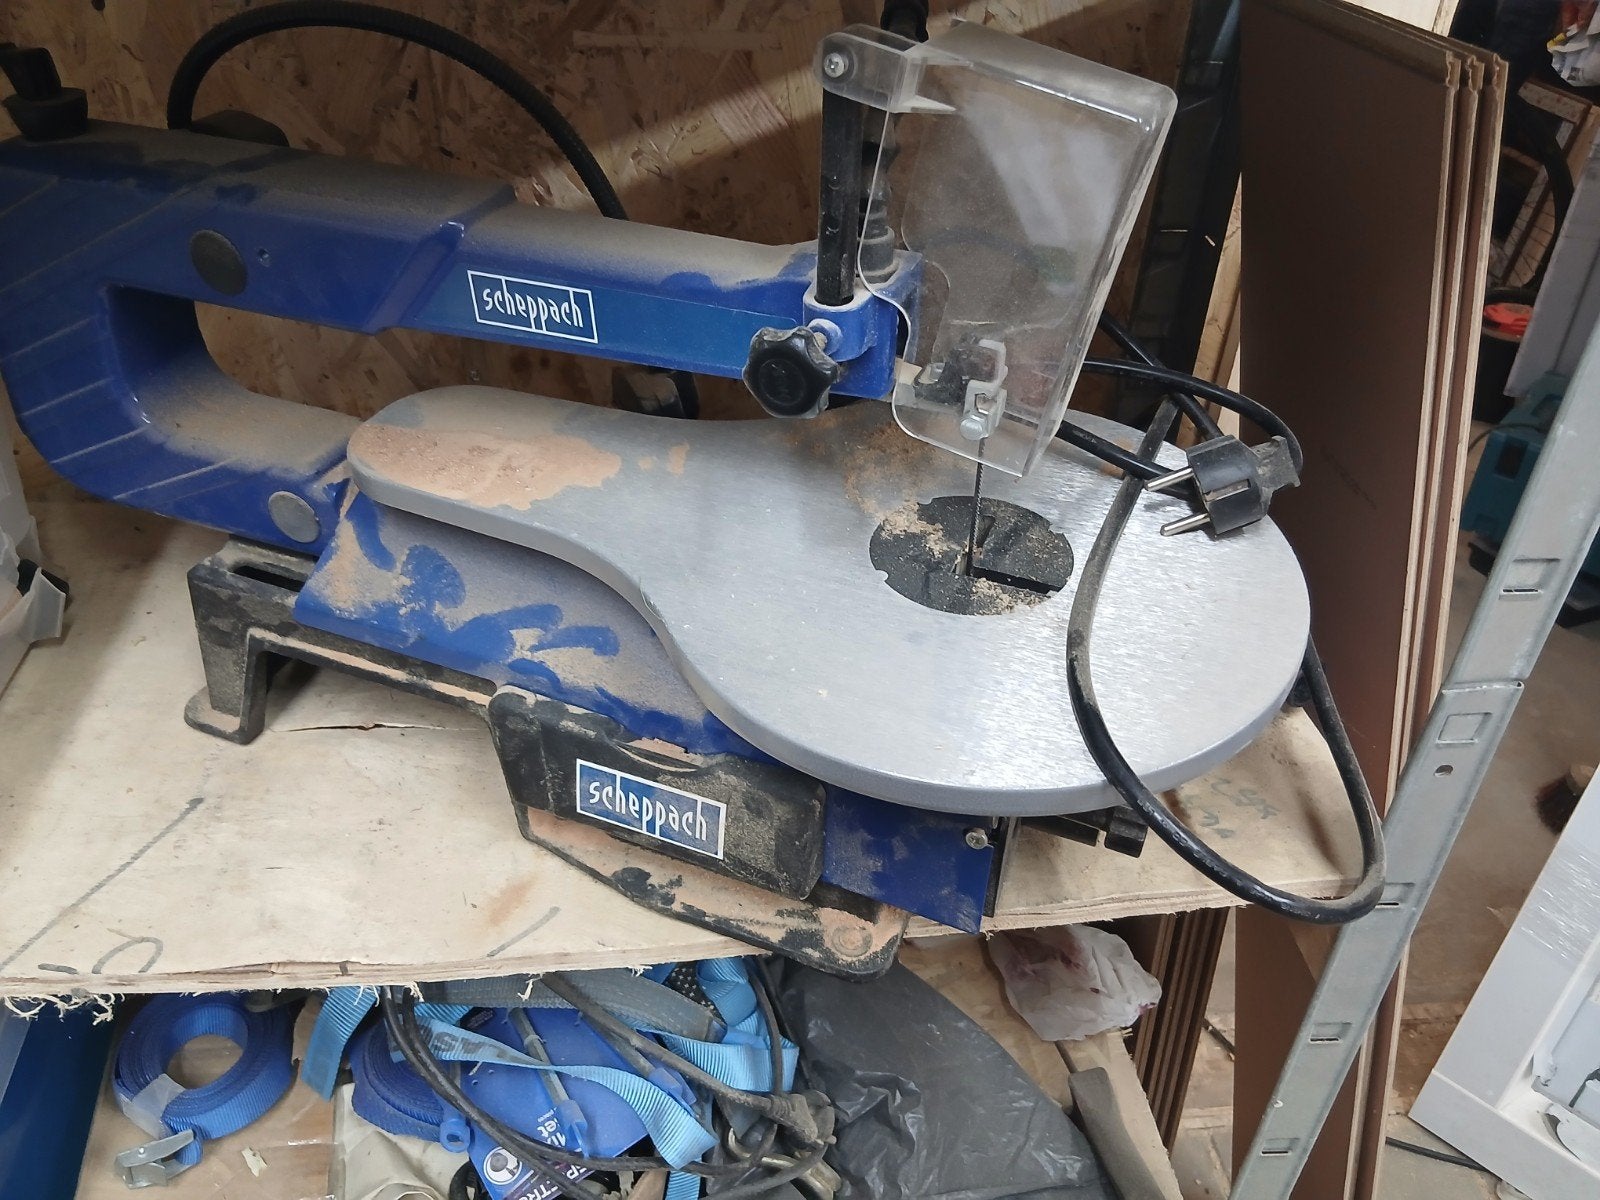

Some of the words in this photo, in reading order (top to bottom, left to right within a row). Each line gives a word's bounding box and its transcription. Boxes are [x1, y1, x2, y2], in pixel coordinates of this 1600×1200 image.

[482, 277, 584, 332] scheppach
[588, 773, 707, 841] scheppach
[537, 1118, 560, 1138] et
